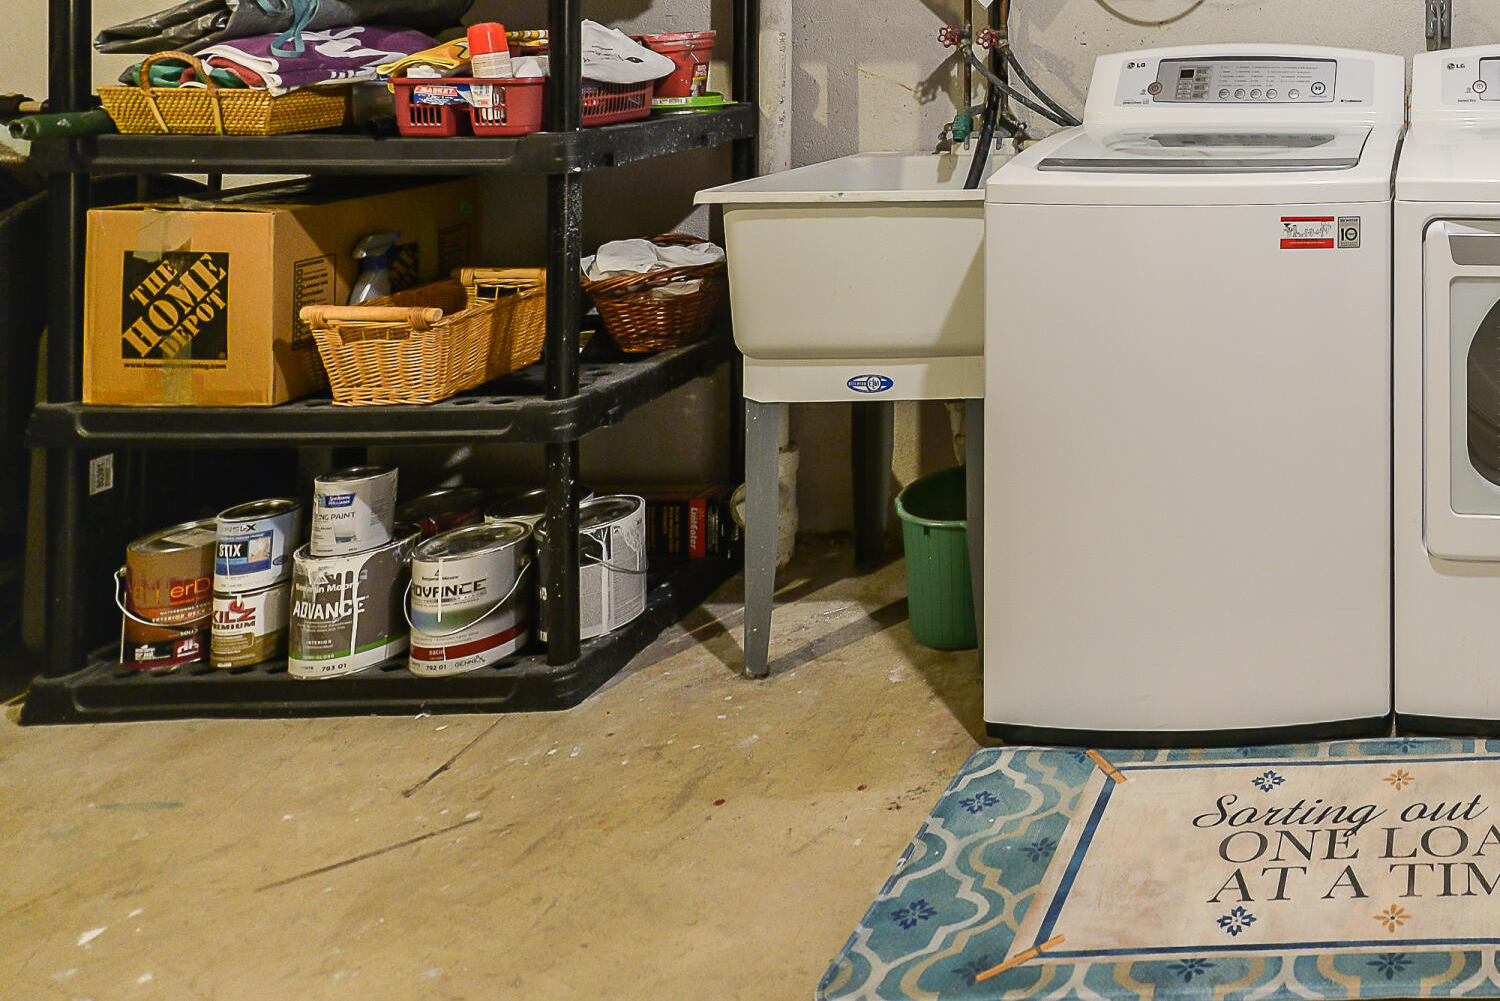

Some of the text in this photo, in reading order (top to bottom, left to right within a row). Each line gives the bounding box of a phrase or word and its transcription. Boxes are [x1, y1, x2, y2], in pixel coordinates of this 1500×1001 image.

[129, 259, 178, 306] THE
[121, 253, 227, 358] HOME
[158, 289, 227, 359] DEPOT
[331, 511, 357, 520] PAINT
[219, 543, 242, 558] STIX
[327, 582, 358, 593] Moor
[293, 596, 365, 619] ADVANCE
[1193, 793, 1389, 837] Sorting
[1401, 794, 1489, 825] out
[1219, 827, 1362, 863] ONE
[1207, 866, 1308, 903] AT
[1322, 864, 1370, 899] A
